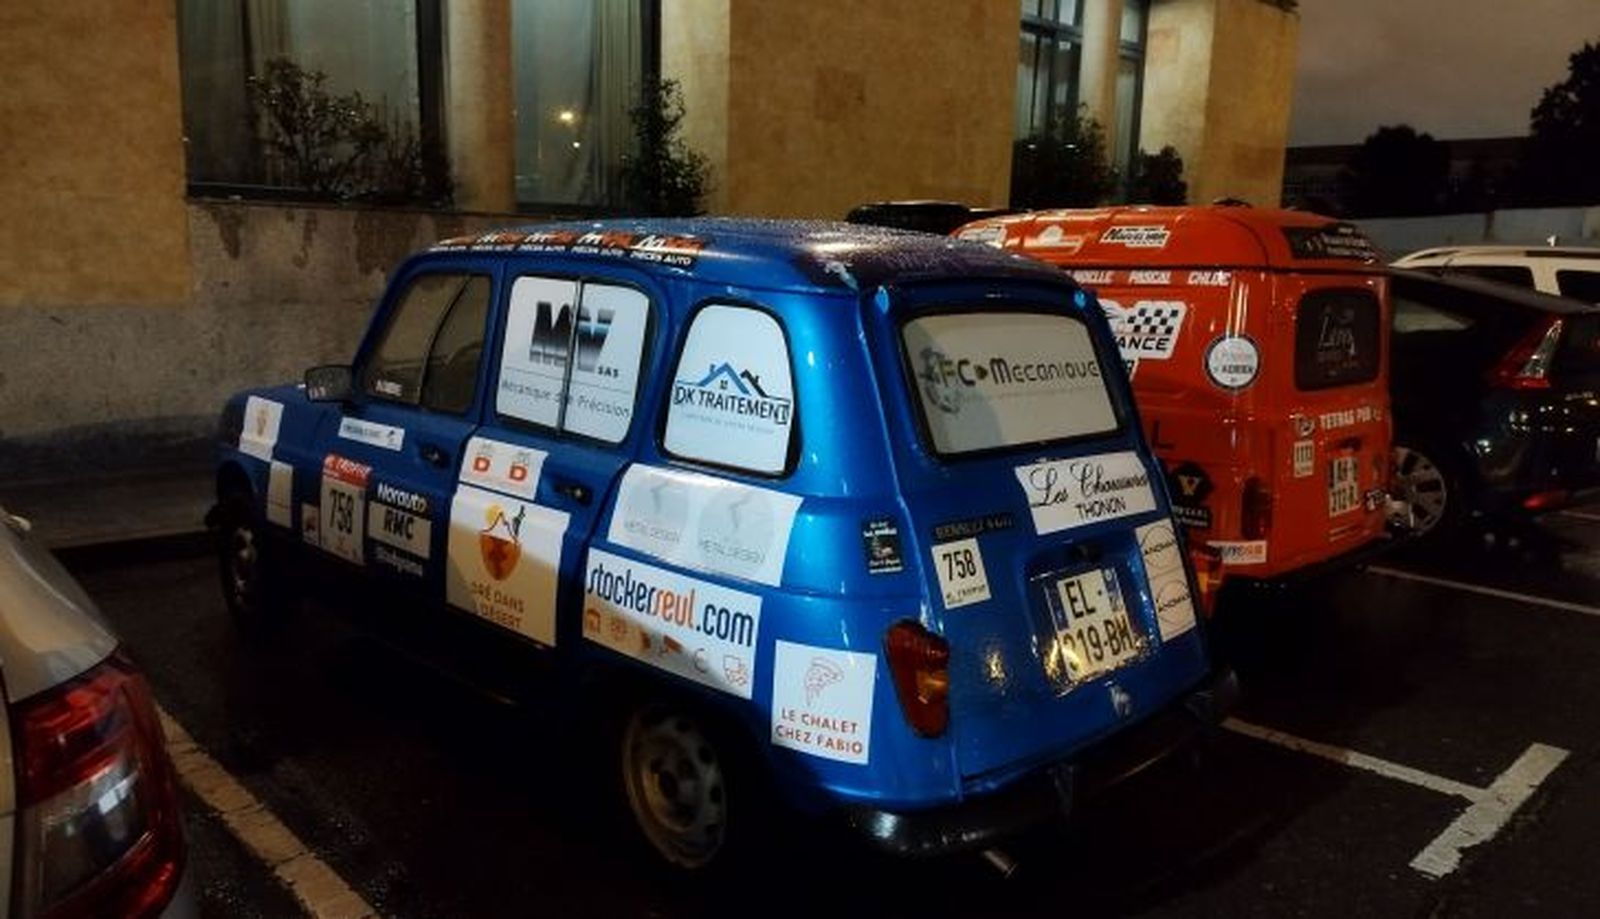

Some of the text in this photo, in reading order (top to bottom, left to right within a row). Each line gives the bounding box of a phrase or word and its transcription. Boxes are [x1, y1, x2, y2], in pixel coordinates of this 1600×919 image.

[663, 254, 692, 266] AUTO
[529, 301, 616, 373] MV
[1115, 335, 1170, 351] ANCE
[597, 366, 619, 378] SAS
[674, 385, 696, 405] DK
[699, 388, 790, 425] TRAITEMENT
[329, 489, 355, 535] 758
[1075, 496, 1127, 519] THONON
[384, 508, 415, 541] RMC
[942, 549, 977, 582] 758
[781, 707, 858, 735] LE CHALET
[775, 724, 863, 755] CHEZ FABIO
